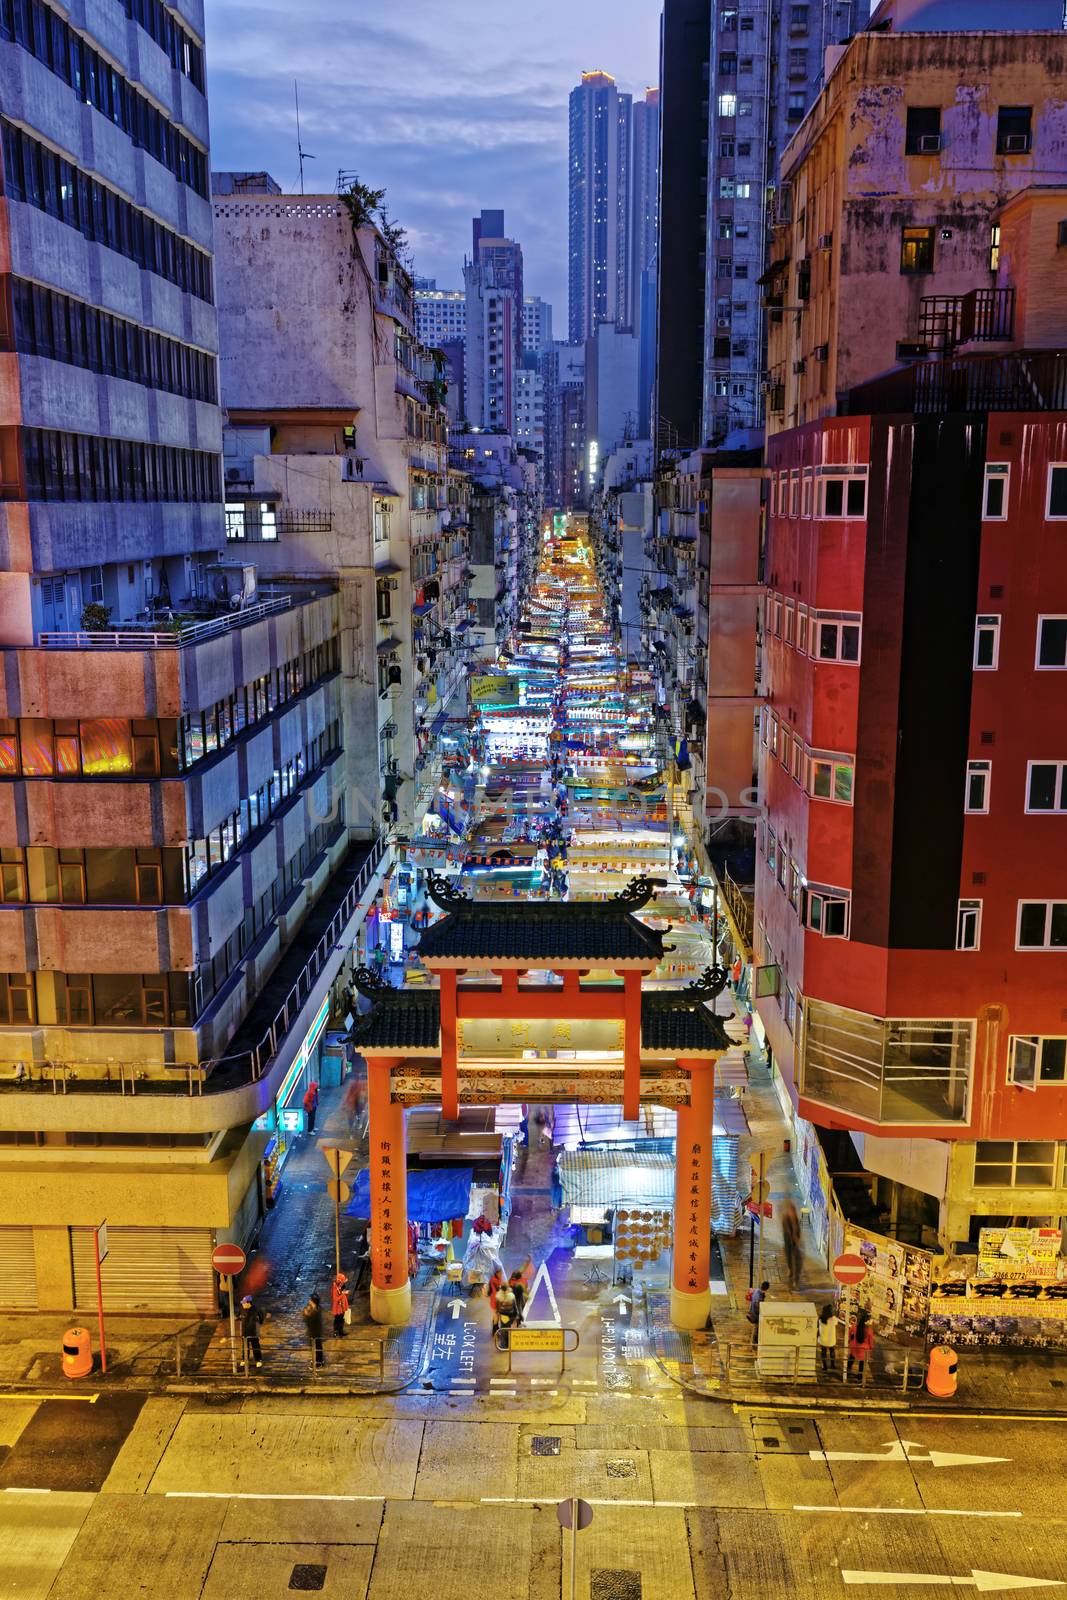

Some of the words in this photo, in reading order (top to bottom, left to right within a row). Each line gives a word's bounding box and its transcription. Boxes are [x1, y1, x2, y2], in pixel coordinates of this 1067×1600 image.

[432, 1333, 456, 1360] 望左
[463, 1322, 477, 1347] LOOK
[459, 1350, 474, 1371] LEFT
[602, 1346, 616, 1373] LOOK
